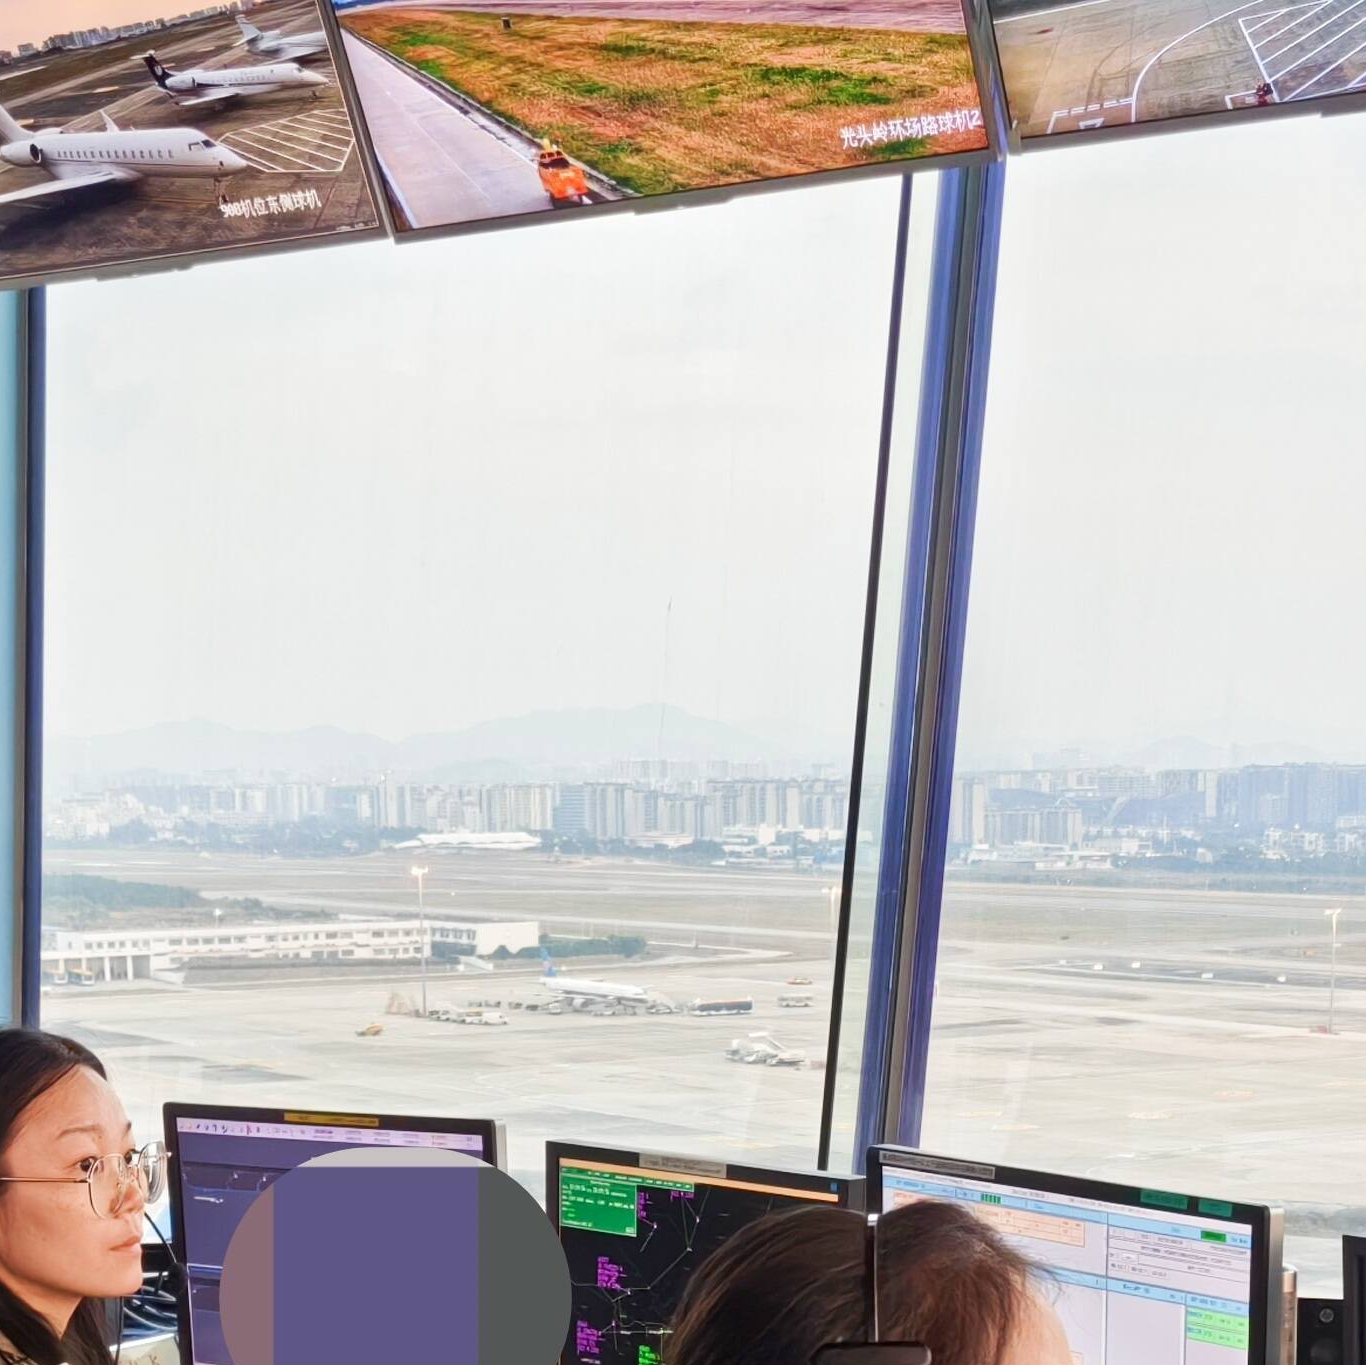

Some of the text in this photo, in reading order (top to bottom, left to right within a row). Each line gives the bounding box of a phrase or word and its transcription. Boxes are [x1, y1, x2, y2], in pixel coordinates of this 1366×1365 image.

[840, 110, 982, 149] 光头岭环场路球机2
